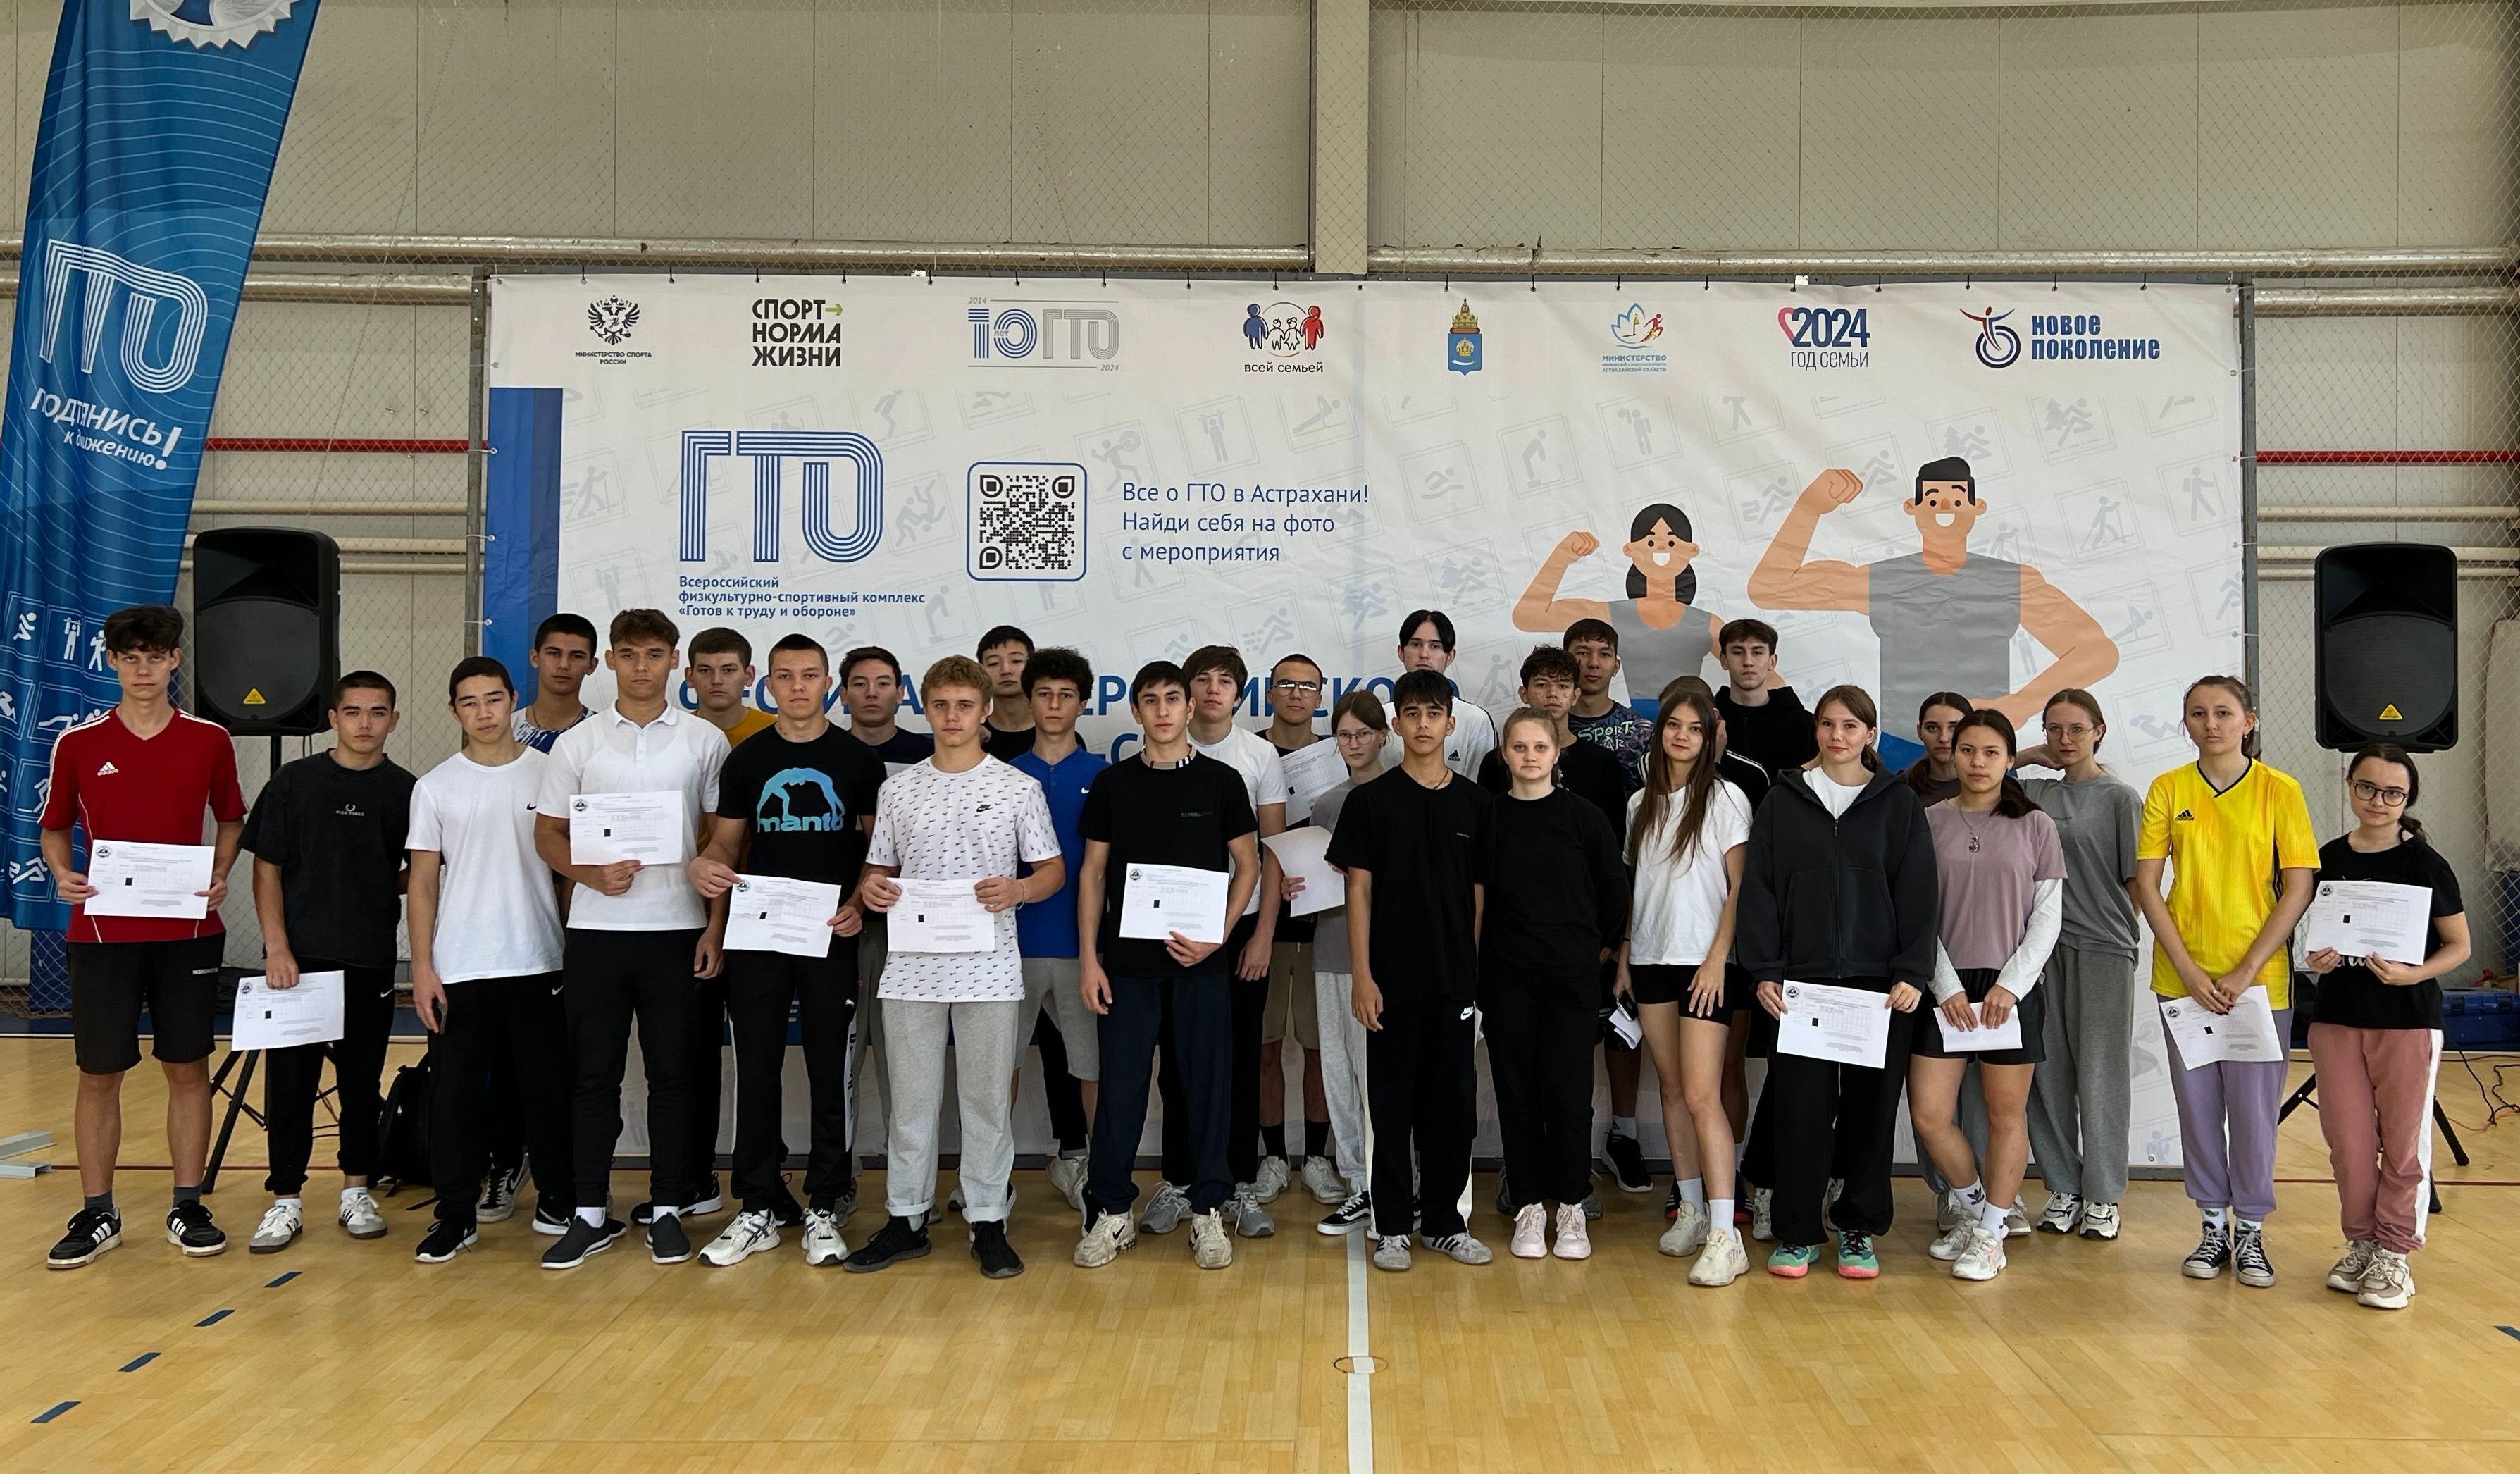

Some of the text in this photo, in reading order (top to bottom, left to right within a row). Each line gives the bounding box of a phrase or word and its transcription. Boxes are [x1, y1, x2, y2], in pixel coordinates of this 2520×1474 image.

[39, 238, 209, 394] ГТО
[752, 299, 826, 320] СПОРТ
[752, 322, 841, 343] НОРМА
[1043, 309, 1119, 360] ГТО
[1791, 307, 1870, 347] 2024
[752, 345, 840, 366] ЖИЗНИ
[1244, 361, 1324, 373] всей семьей
[63, 431, 74, 445] к
[680, 430, 884, 563] ГТО
[1123, 483, 1369, 507] Все о ГТО в Астрахани!
[1123, 512, 1335, 536] Найди себя на фото
[1122, 545, 1279, 565] с мероприятия
[679, 576, 779, 590] Всероссийский
[679, 590, 926, 605] физкультурно-спортивный комплекс
[679, 605, 856, 619] «Готов к труду и обороне»
[757, 812, 844, 832] manto
